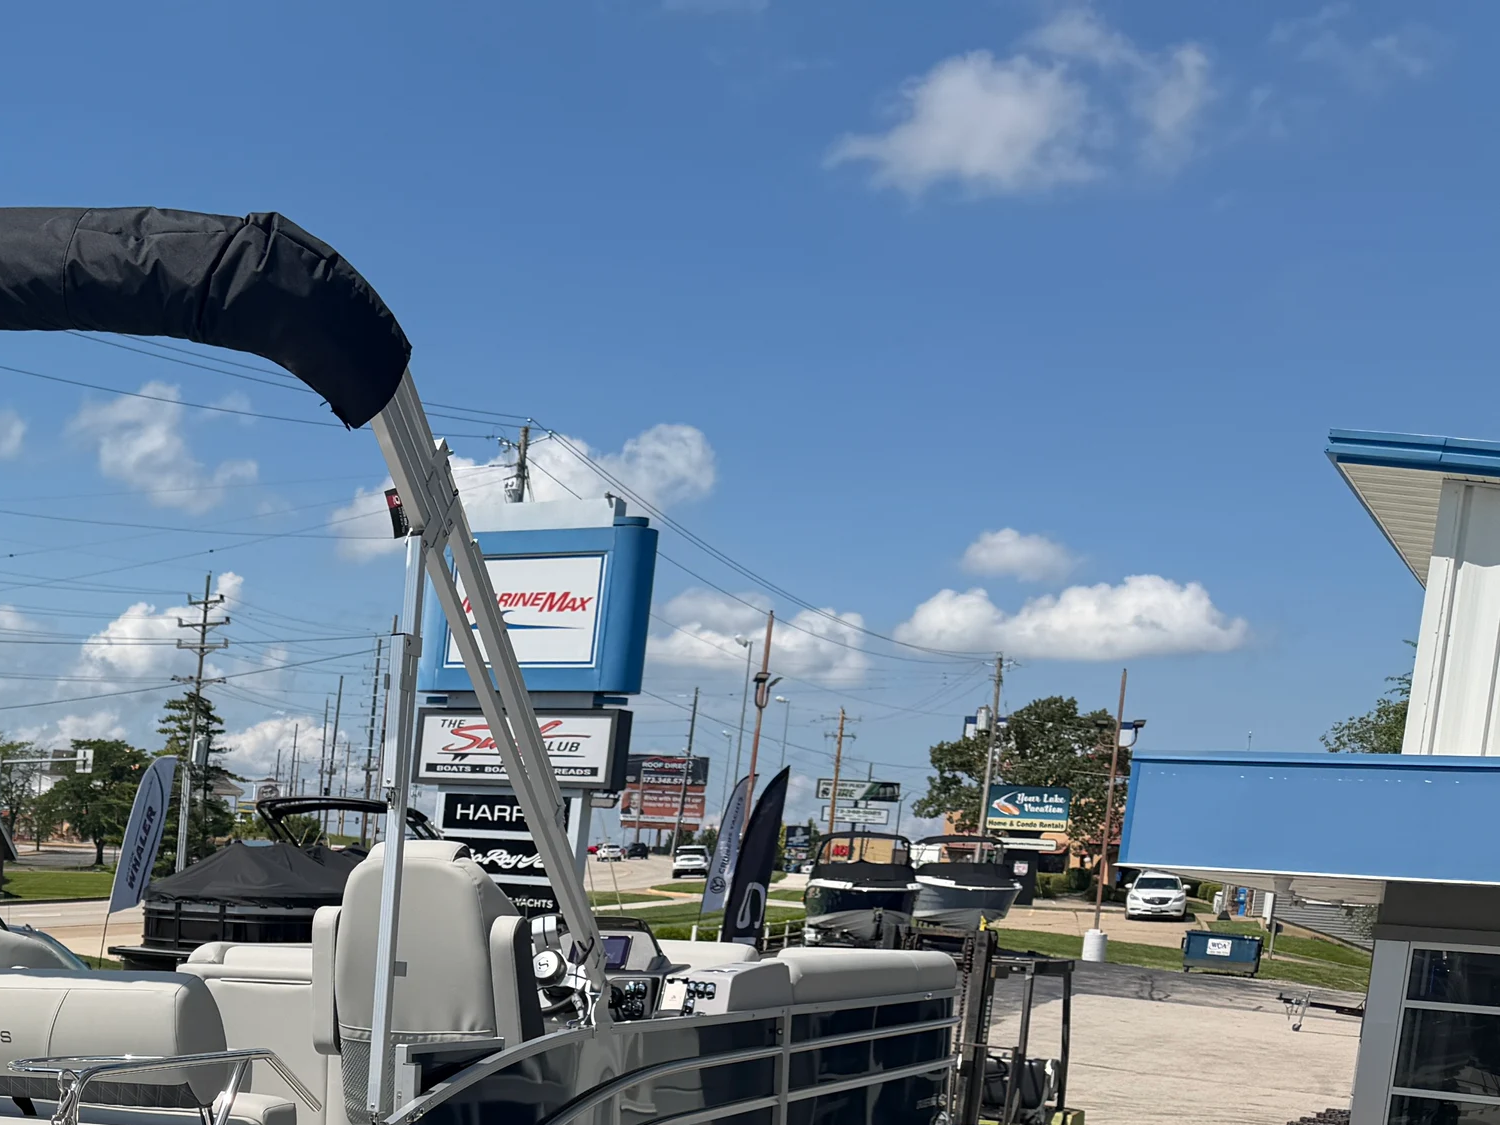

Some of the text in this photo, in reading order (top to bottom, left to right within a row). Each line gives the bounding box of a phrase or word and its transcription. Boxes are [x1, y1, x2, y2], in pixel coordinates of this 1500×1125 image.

[441, 719, 467, 729] THE
[547, 741, 581, 752] LUB
[1015, 792, 1066, 804] Your Lake
[456, 804, 527, 822] HARR
[1024, 803, 1065, 814] Vacation
[127, 805, 157, 890] WHALER
[515, 897, 554, 909] YACHTS
